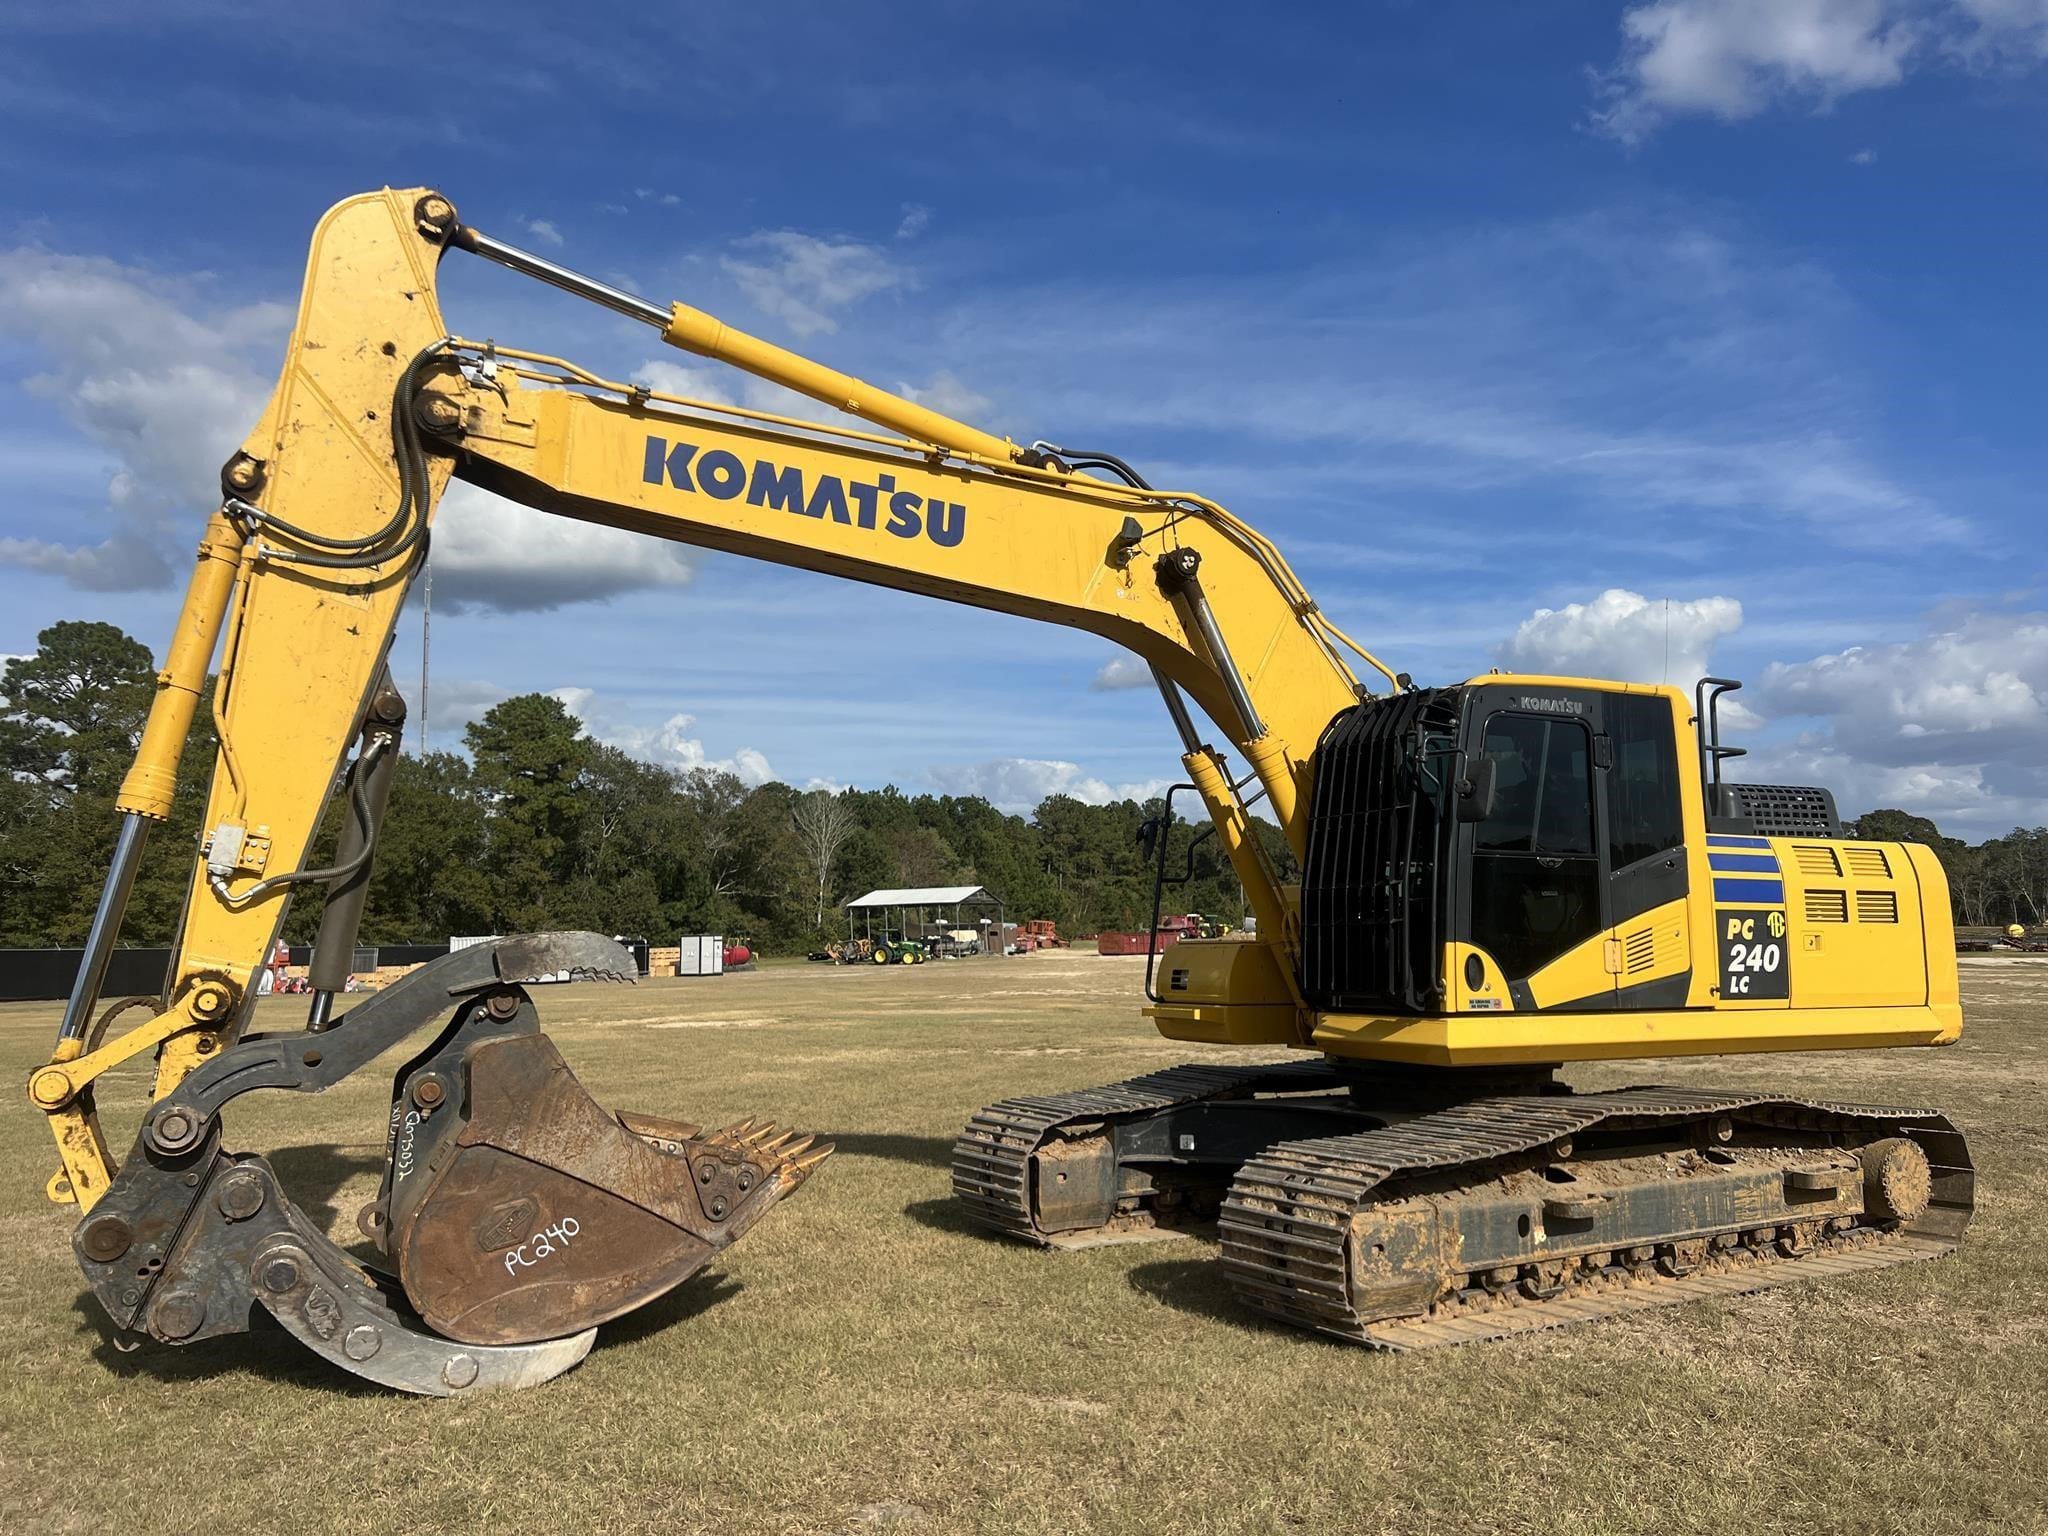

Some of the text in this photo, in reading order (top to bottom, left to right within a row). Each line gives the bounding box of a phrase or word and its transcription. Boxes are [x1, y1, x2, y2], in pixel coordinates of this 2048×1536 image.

[643, 435, 967, 548] KOMATSU
[1520, 696, 1583, 714] KOMATSU
[1727, 918, 1754, 940] PC
[1728, 944, 1780, 973] 240
[1729, 975, 1750, 994] LC
[504, 1217, 580, 1276] PC240
